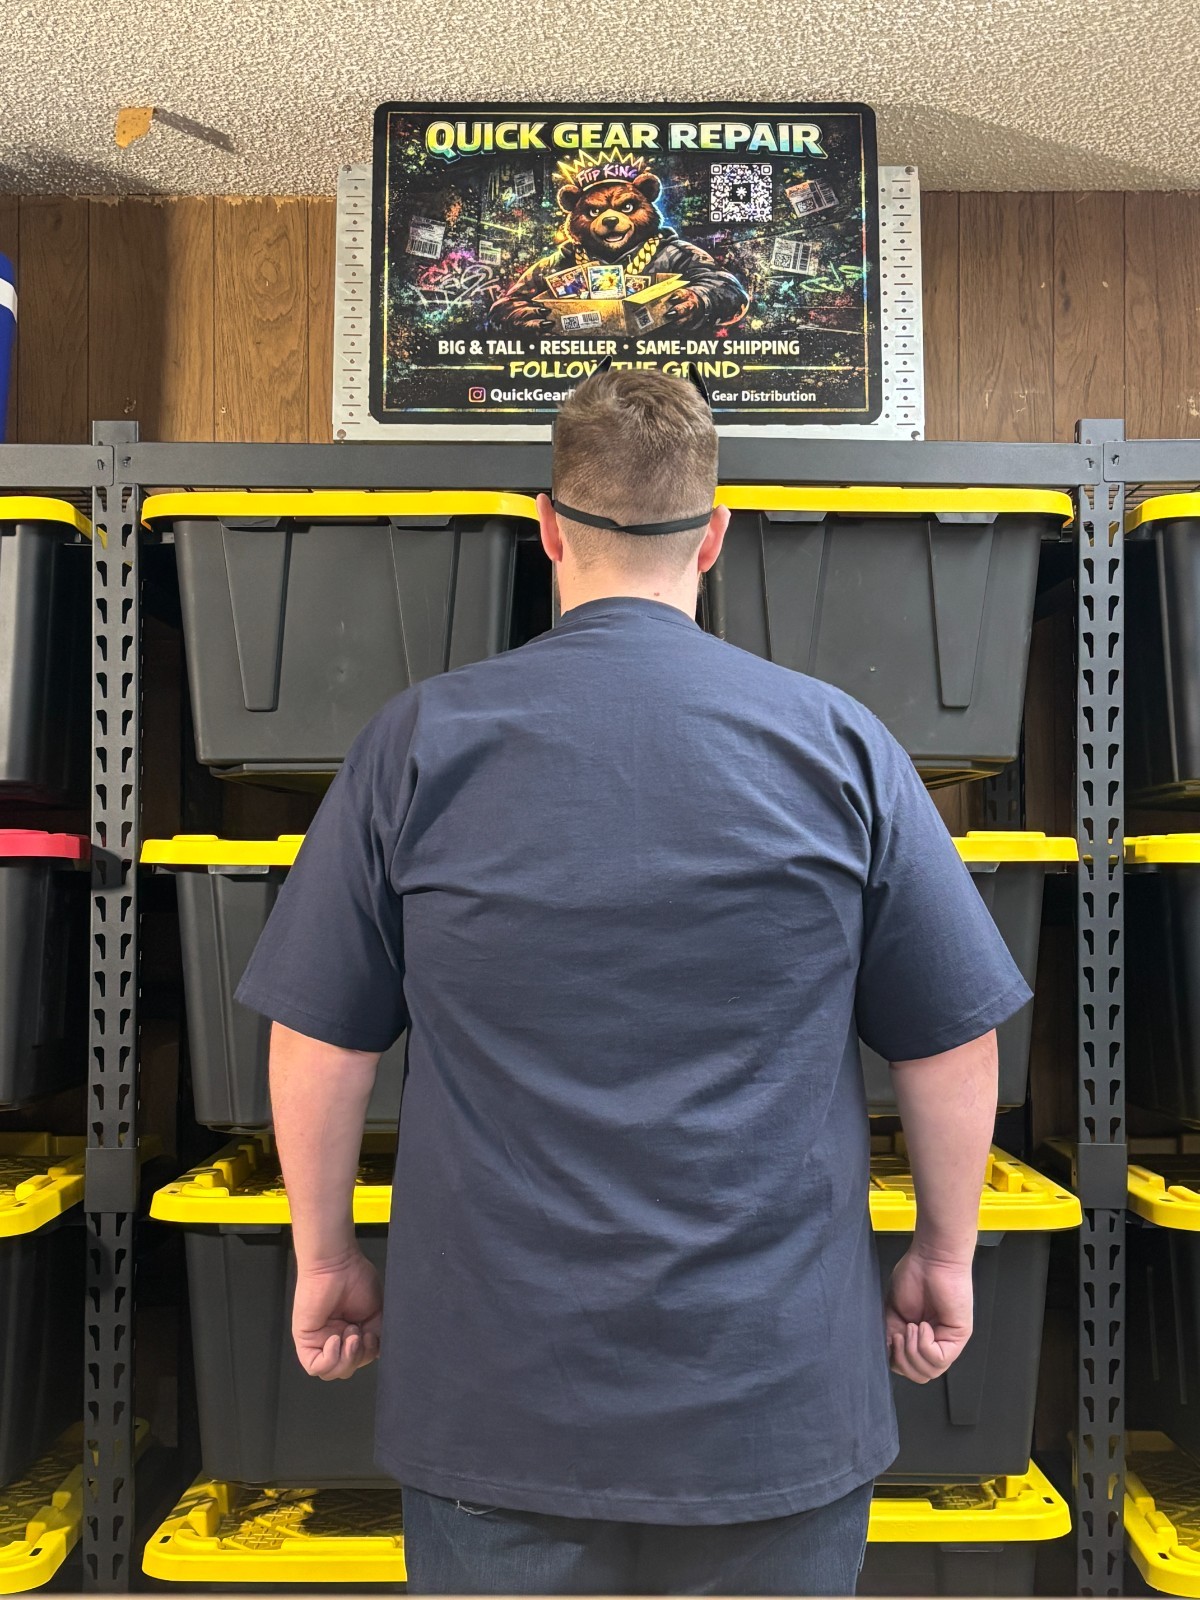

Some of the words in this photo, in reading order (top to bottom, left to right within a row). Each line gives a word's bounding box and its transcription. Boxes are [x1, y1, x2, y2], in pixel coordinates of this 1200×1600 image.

[425, 121, 549, 160] QUICK
[552, 122, 661, 150] GEAR
[669, 122, 827, 157] REPAIR
[438, 340, 466, 355] BIG
[469, 340, 483, 355] &
[486, 340, 525, 355] TALL
[540, 340, 617, 355] RESELLER
[636, 340, 719, 355] SAME-DAY
[723, 340, 800, 355] SHIPPING
[711, 390, 738, 402] Gear
[741, 390, 816, 402] Distribution
